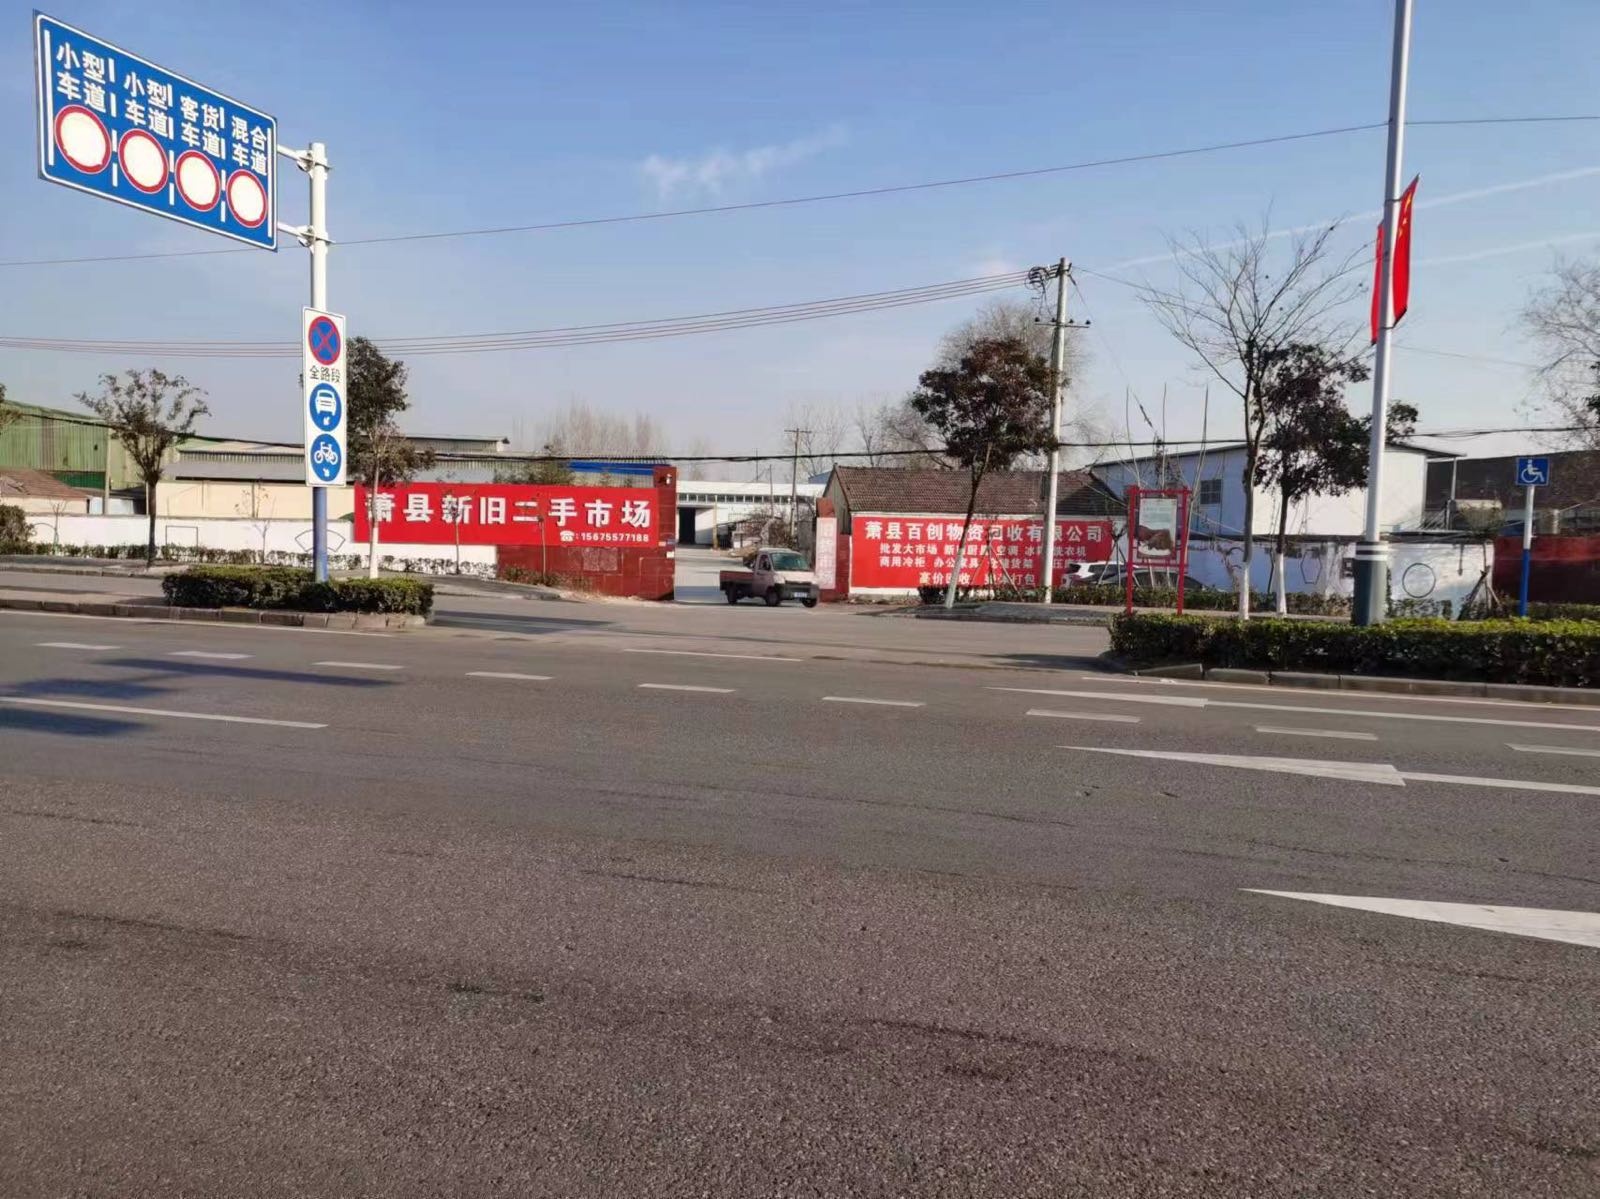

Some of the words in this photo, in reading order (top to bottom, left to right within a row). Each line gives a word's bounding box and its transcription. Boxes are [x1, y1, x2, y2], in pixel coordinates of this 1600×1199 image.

[56, 42, 106, 84] 小型
[56, 72, 106, 113] 车道
[124, 72, 168, 110] 小型
[124, 99, 169, 138] 车道
[180, 95, 220, 131] 客货
[181, 123, 220, 158] 车道
[231, 116, 267, 148] 混合
[232, 143, 267, 176] 车道
[310, 365, 341, 383] 全路段
[365, 492, 650, 527] 萧县新旧二手市场
